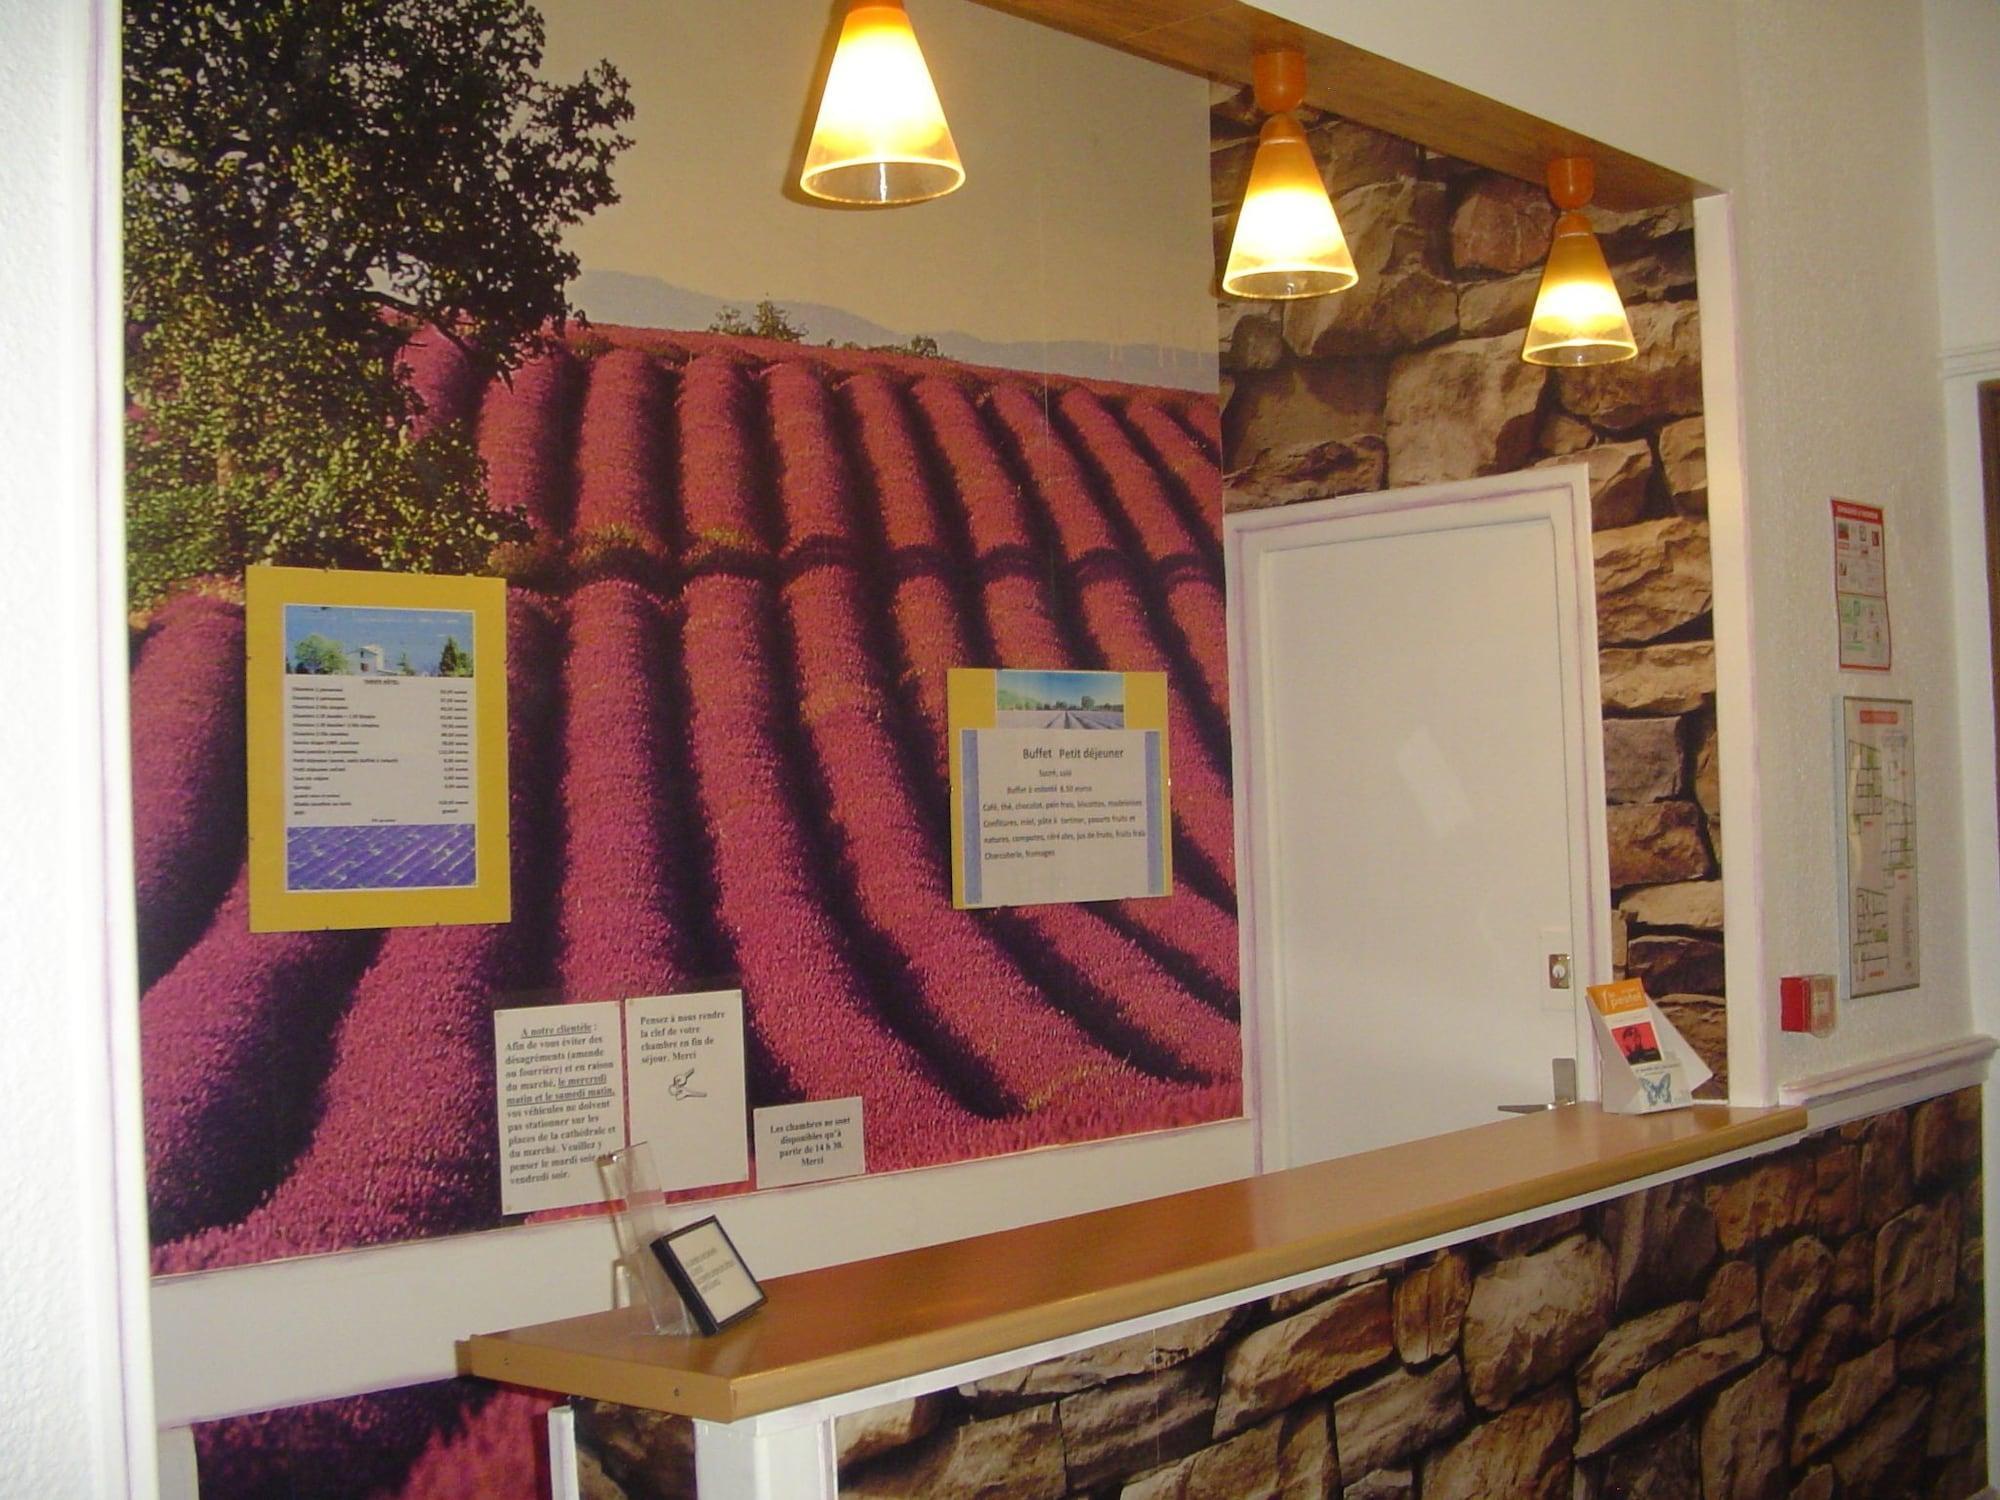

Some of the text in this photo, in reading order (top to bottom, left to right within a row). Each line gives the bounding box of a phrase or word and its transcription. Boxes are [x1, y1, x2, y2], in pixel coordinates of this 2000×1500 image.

[1023, 747, 1124, 761] Buffet Petit déjeuner
[640, 1011, 725, 1025] Pensez à nous rendre
[531, 1027, 554, 1036] notre
[640, 1026, 700, 1038] la clef de votre
[505, 1041, 524, 1051] Afin
[527, 1041, 537, 1049] de
[562, 1037, 586, 1047] éviter
[589, 1036, 603, 1044] des
[641, 1036, 714, 1051] chambre en fin de
[505, 1048, 604, 1065] désagréments (amende
[672, 1052, 697, 1060] Merci
[520, 1065, 562, 1076] fourrière)
[588, 1061, 614, 1070] raison
[506, 1083, 518, 1091] du
[558, 1079, 566, 1088] le
[568, 1074, 607, 1086] mercredi
[506, 1095, 533, 1106] matin
[535, 1095, 543, 1103] et
[545, 1092, 554, 1102] le
[555, 1090, 586, 1100] samedi
[524, 1105, 564, 1116] véhicules
[578, 1101, 610, 1111] doivent
[507, 1114, 600, 1134] pas stationner sur les
[770, 1125, 784, 1134] Les
[785, 1120, 822, 1132] chambres
[508, 1136, 536, 1148] places
[538, 1134, 548, 1142] de
[550, 1132, 559, 1140] la
[560, 1127, 606, 1139] cathédrale
[780, 1132, 822, 1145] disponibles
[509, 1149, 520, 1158] du
[561, 1141, 595, 1152] Veuillez
[779, 1145, 802, 1159] partir
[804, 1145, 813, 1154] de
[815, 1144, 824, 1152] 14
[510, 1163, 539, 1174] penser
[541, 1160, 550, 1168] le
[551, 1156, 577, 1166] mardi
[579, 1154, 596, 1163] soir
[801, 1156, 824, 1166] Merci
[510, 1173, 549, 1184] vendredi
